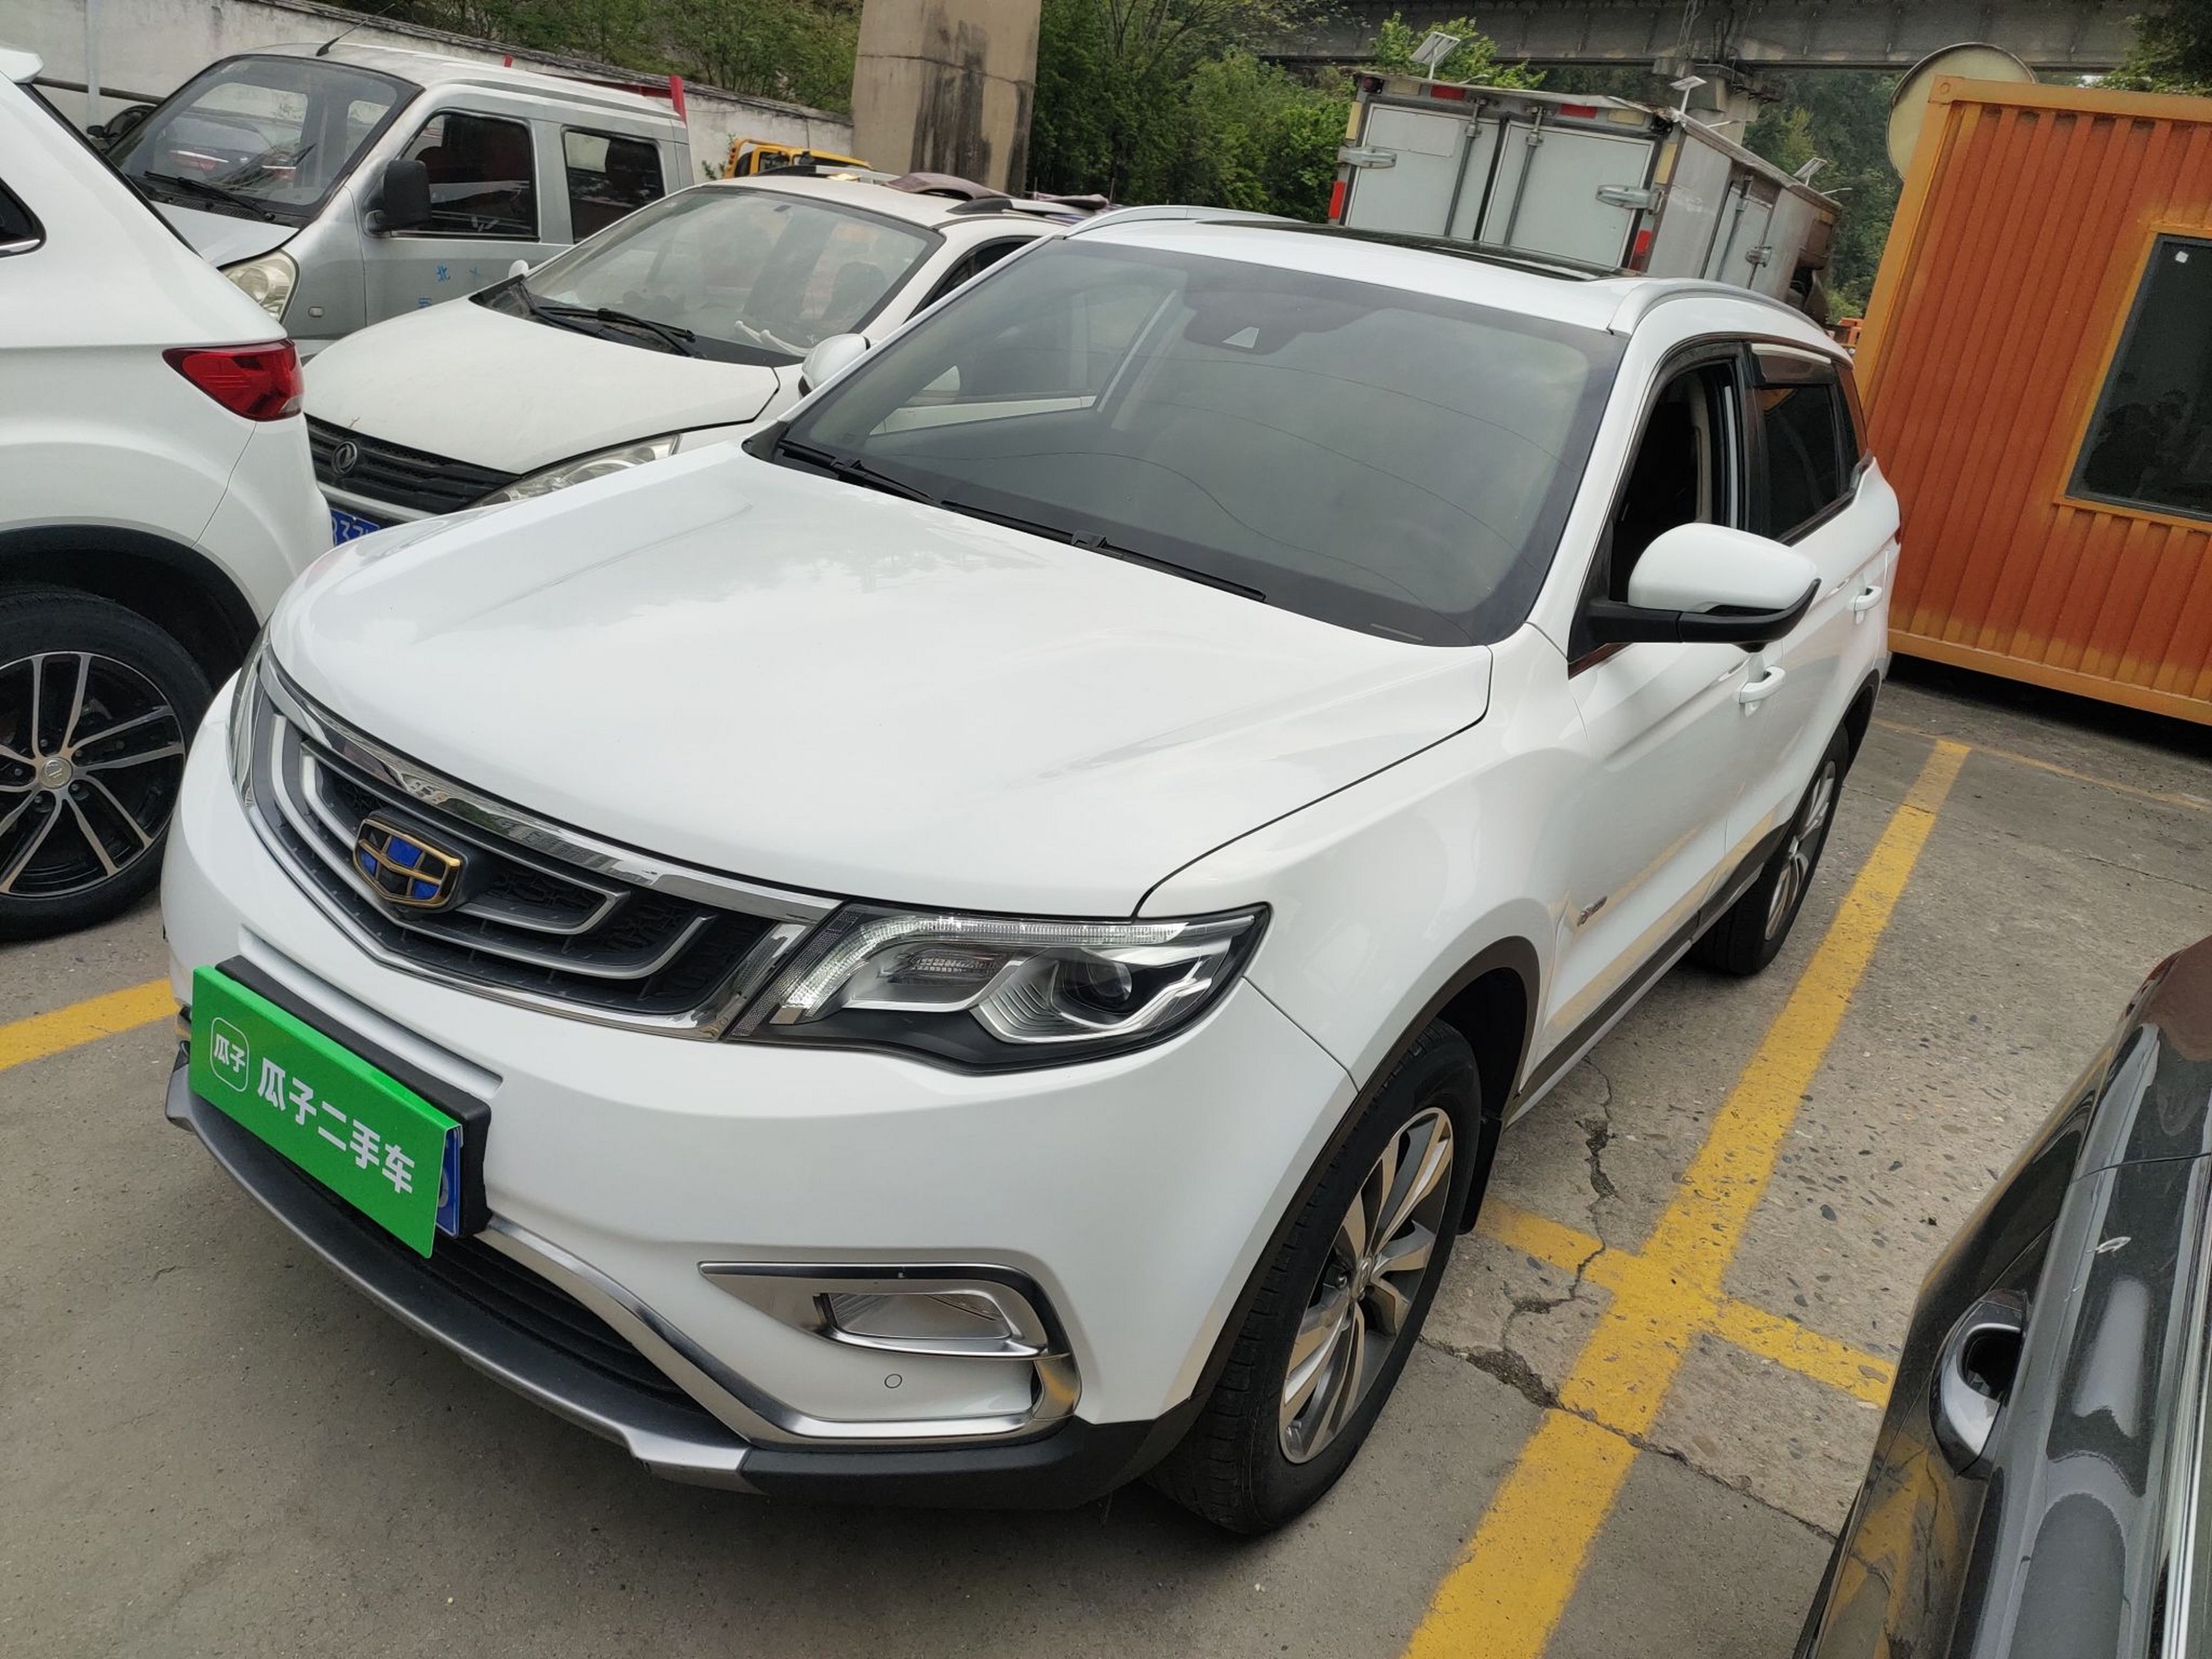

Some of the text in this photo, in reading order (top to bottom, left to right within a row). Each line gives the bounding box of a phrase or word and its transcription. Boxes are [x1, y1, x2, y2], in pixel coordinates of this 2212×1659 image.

[213, 1033, 246, 1073] 瓜子
[257, 1056, 415, 1194] 瓜子二手车
